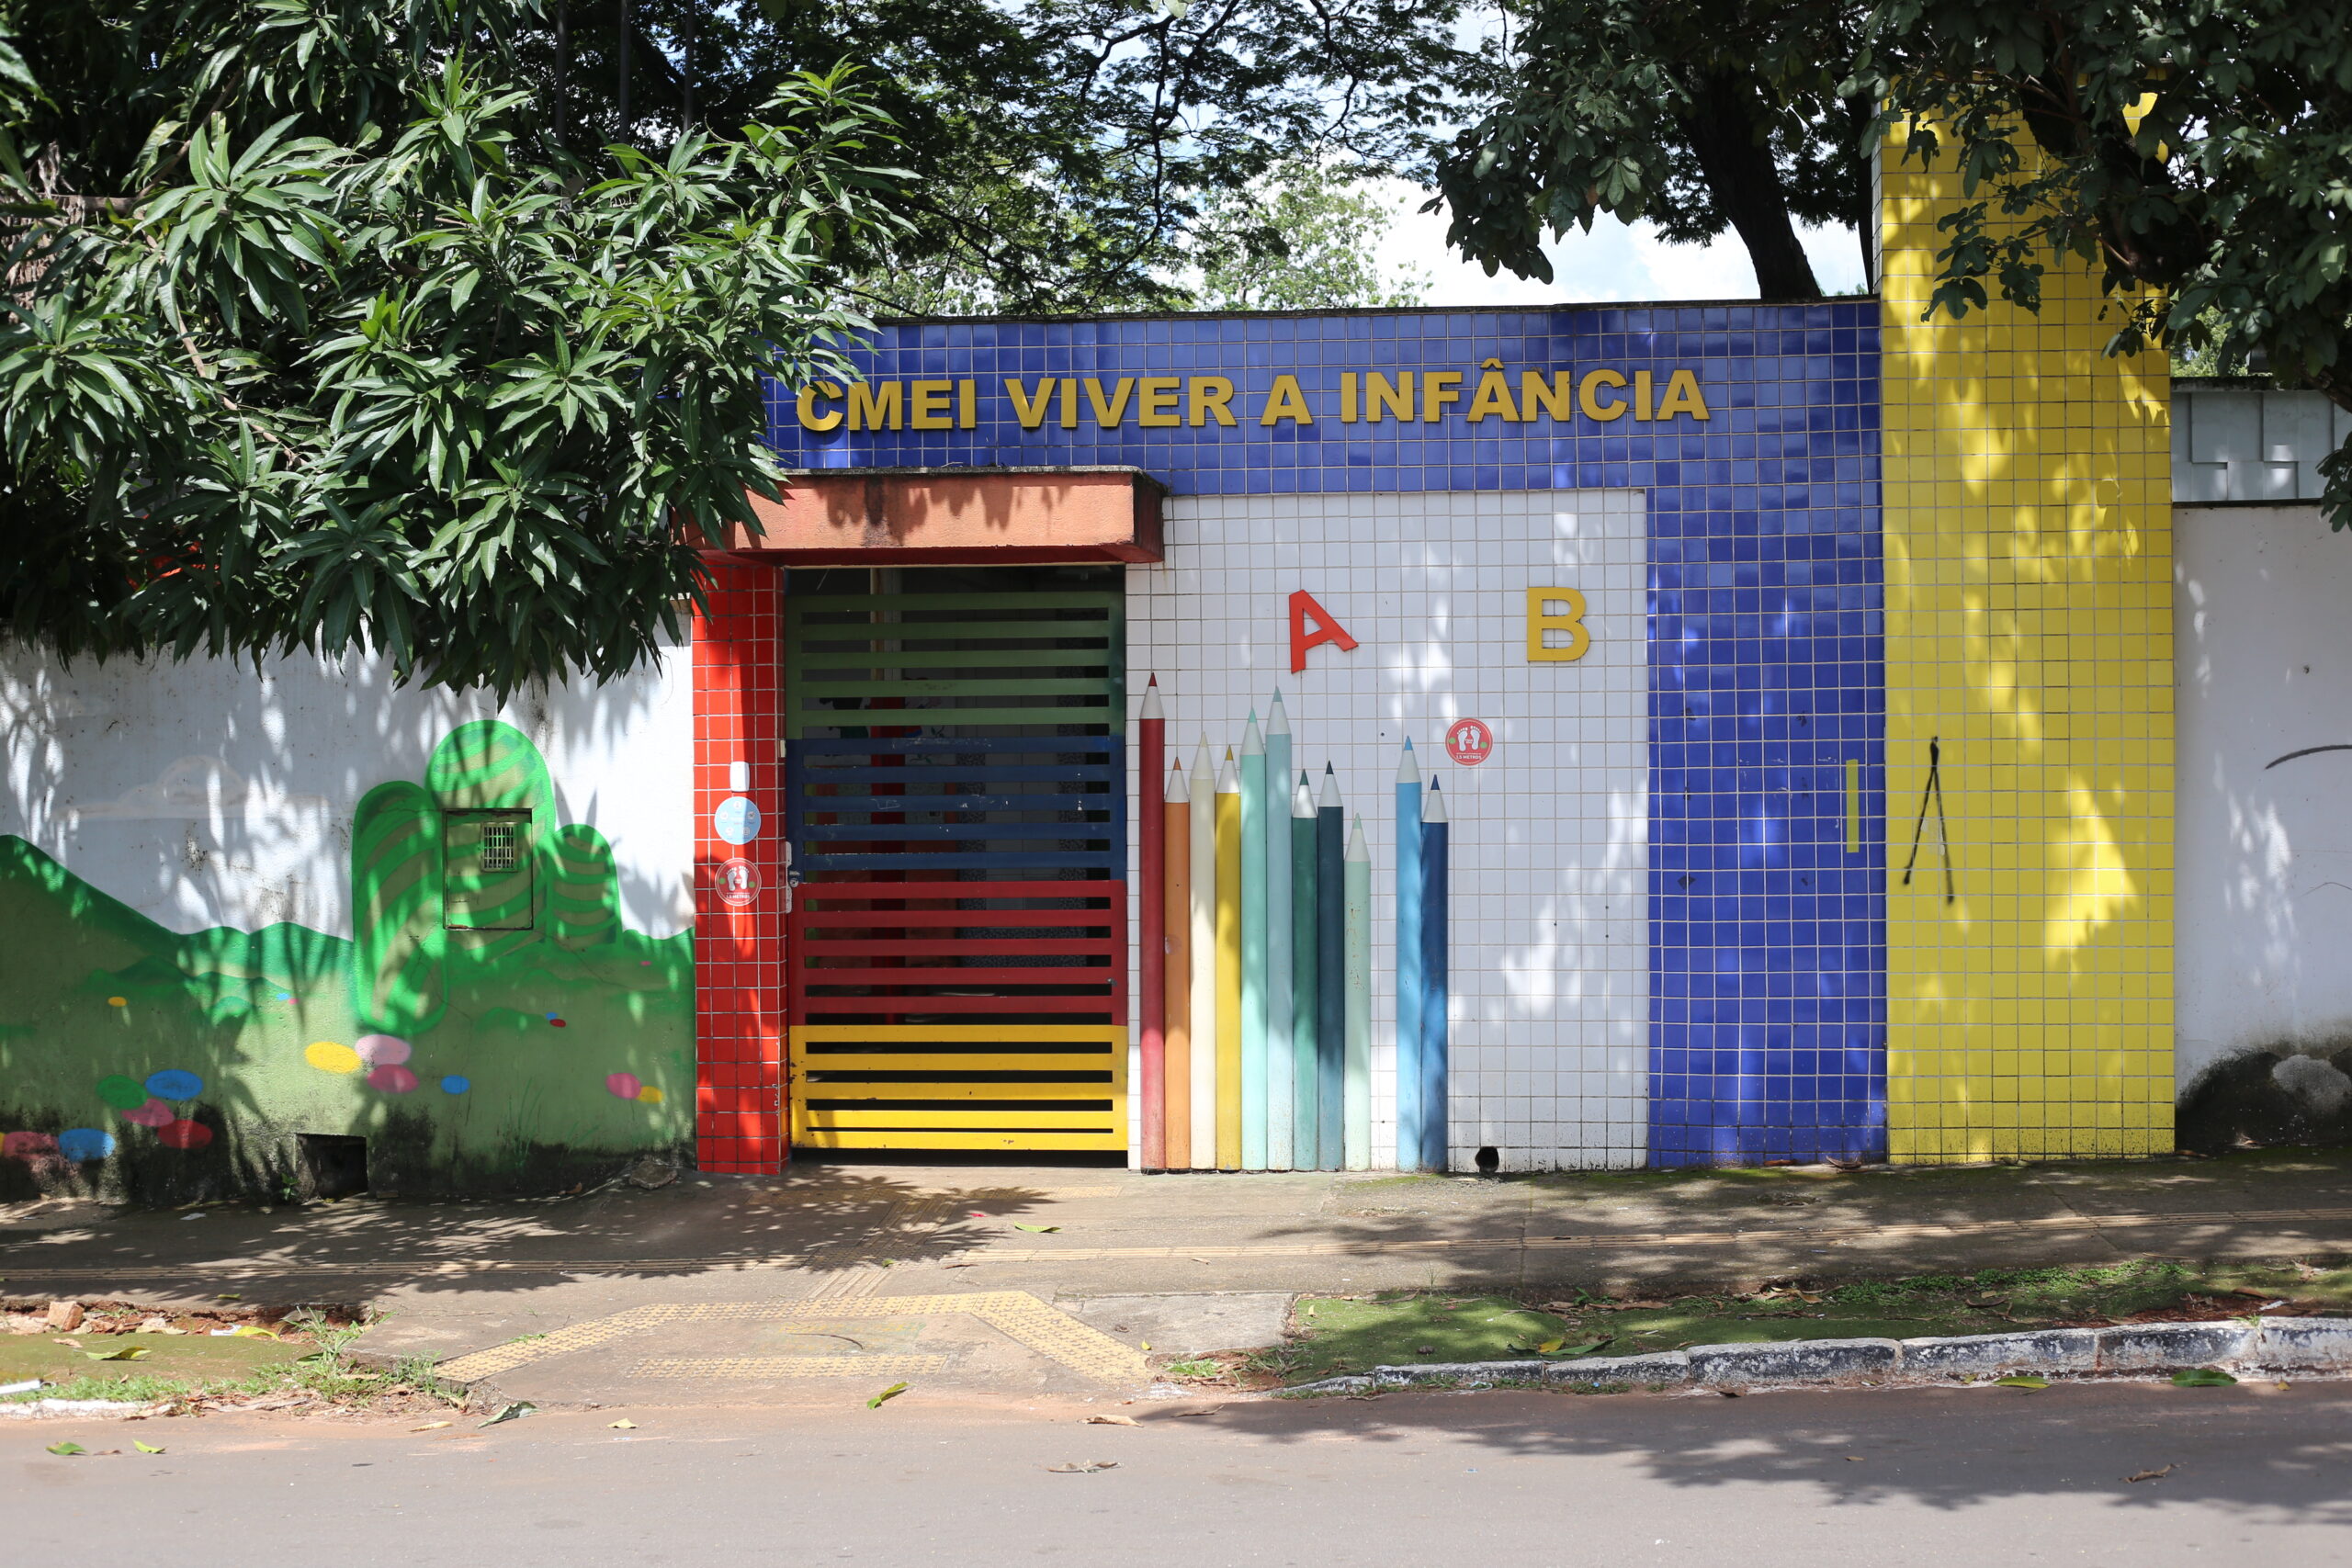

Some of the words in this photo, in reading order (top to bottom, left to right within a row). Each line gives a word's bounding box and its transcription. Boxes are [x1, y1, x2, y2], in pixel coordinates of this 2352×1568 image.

[797, 378, 977, 432] CMEI
[1003, 376, 1238, 428] VIVER
[1260, 374, 1314, 425] A
[1340, 357, 1711, 423] INFÂNCIA
[1288, 589, 1359, 674] A
[1526, 586, 1591, 661] B
